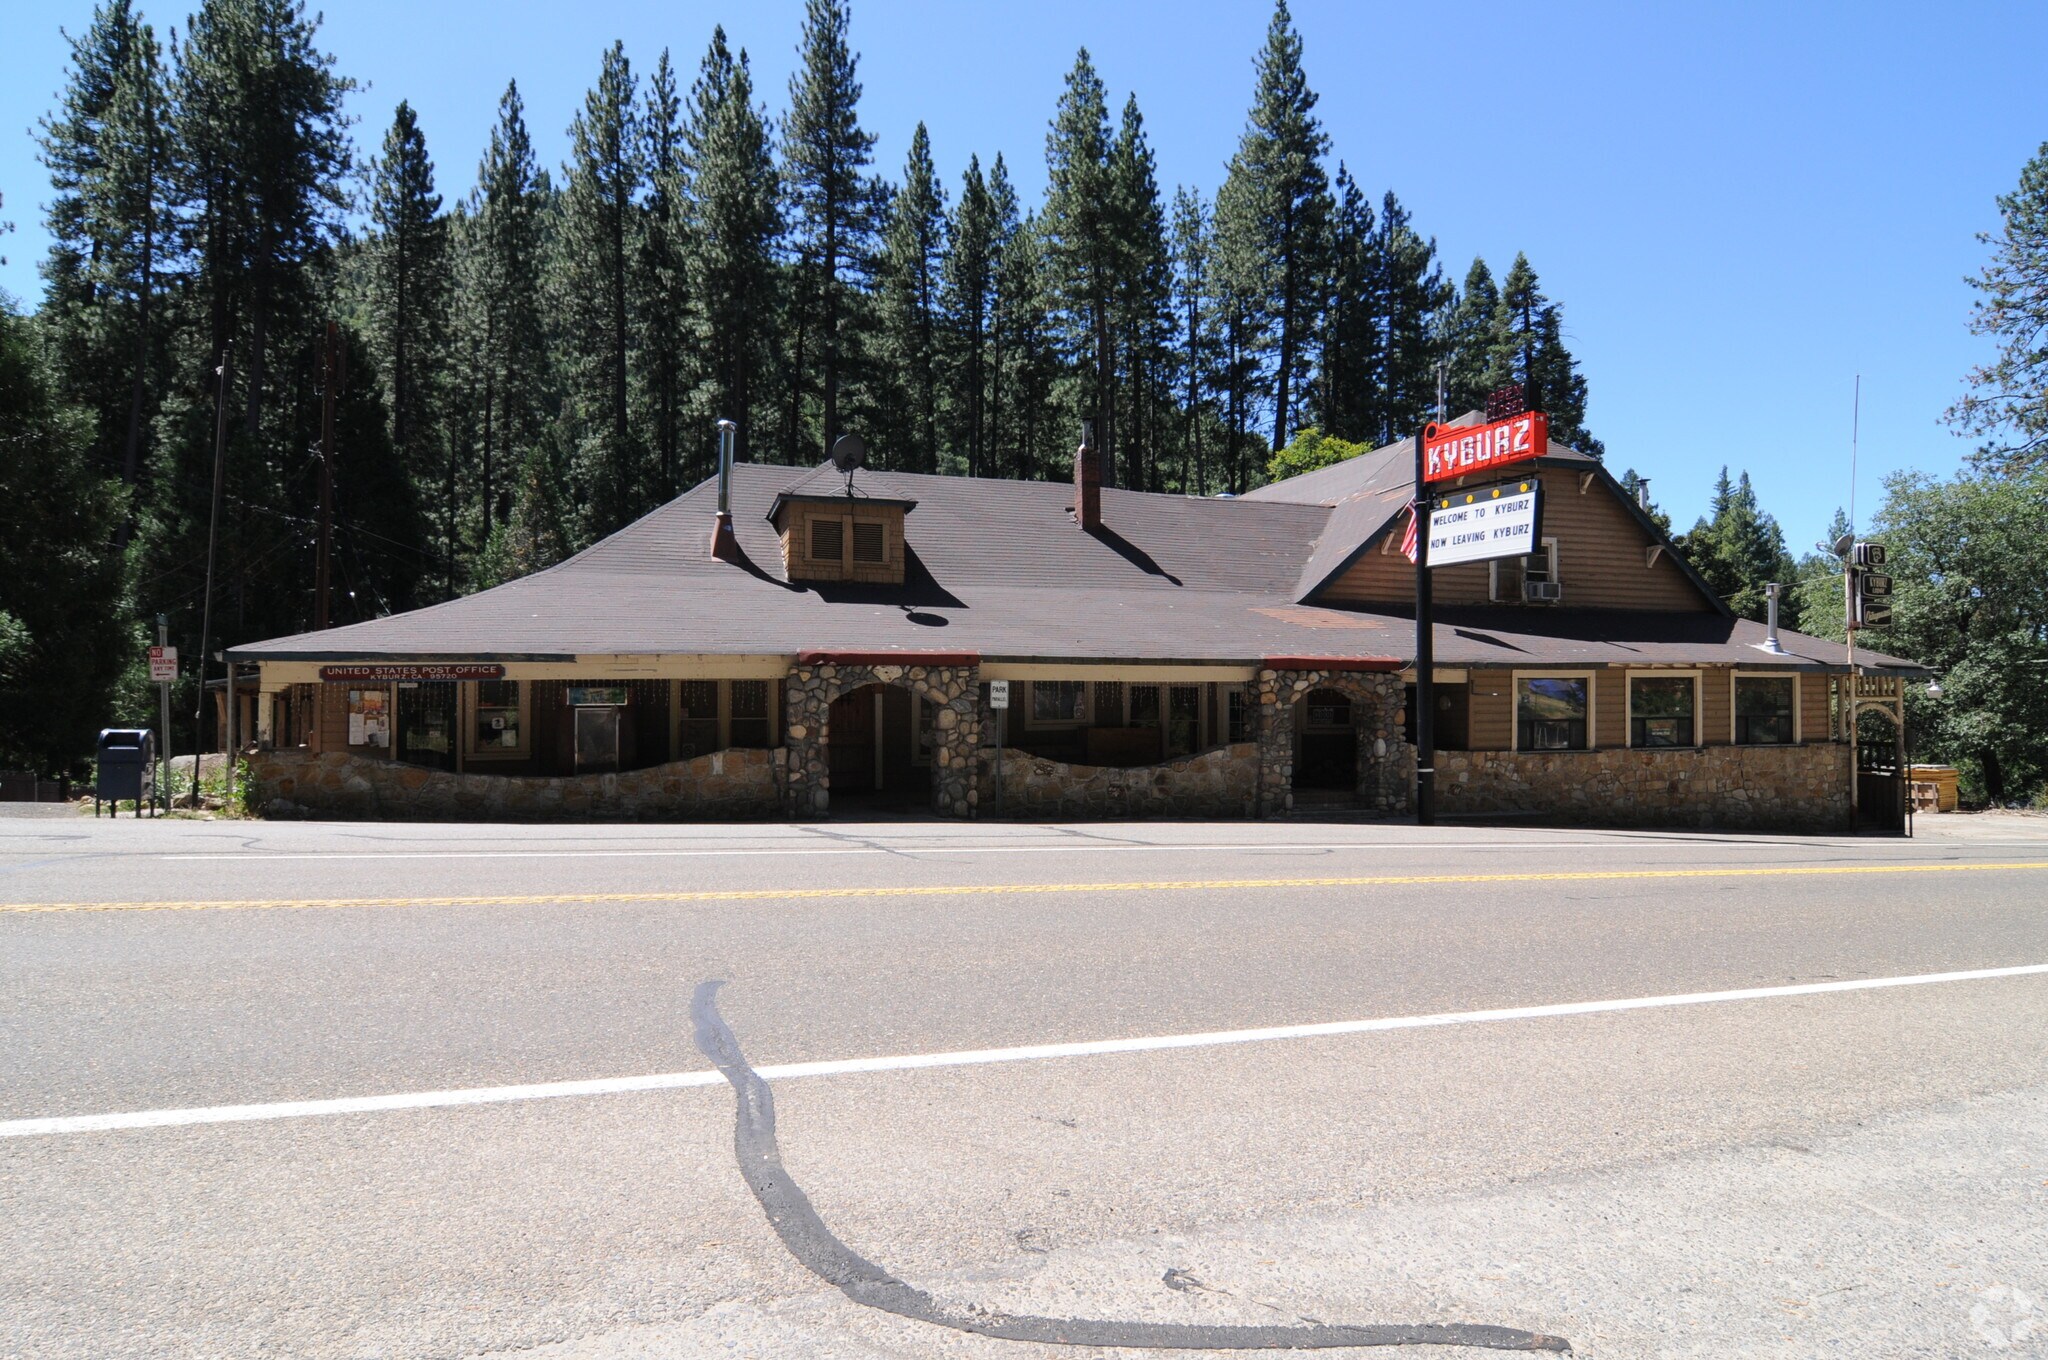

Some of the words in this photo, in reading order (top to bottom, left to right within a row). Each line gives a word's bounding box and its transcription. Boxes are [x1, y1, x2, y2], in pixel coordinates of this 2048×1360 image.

[1488, 383, 1524, 405] OPEN
[1428, 419, 1530, 475] KYBURZ
[1433, 511, 1468, 526] WELCOME
[1475, 508, 1486, 518] TO
[1495, 499, 1530, 515] KYBURZ
[1430, 537, 1447, 549] NOW
[1452, 531, 1486, 545] LEAVING
[1493, 523, 1530, 539] KYBURZ
[151, 649, 162, 657] NO
[327, 667, 370, 675] UNITED
[375, 667, 417, 675] STATES
[422, 666, 451, 674] POST
[456, 666, 497, 674] OFFICE
